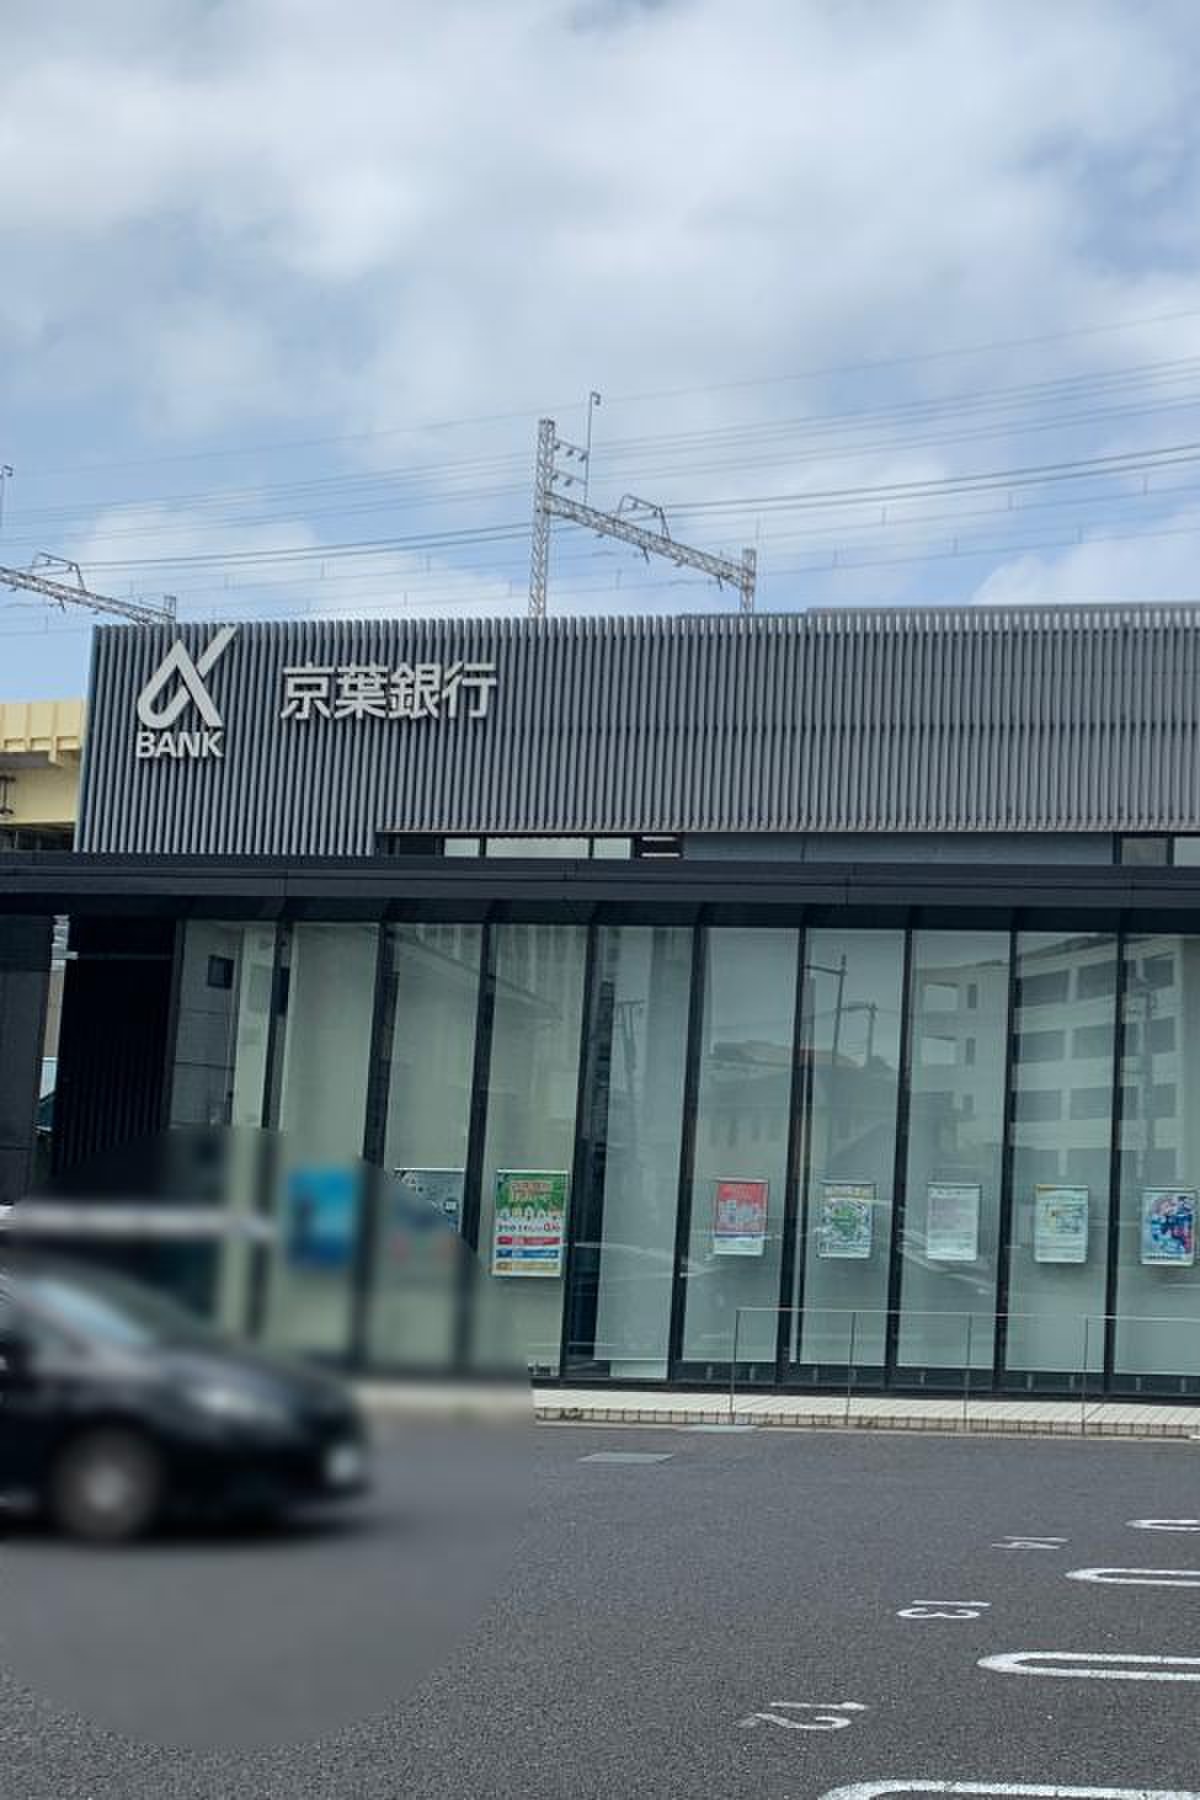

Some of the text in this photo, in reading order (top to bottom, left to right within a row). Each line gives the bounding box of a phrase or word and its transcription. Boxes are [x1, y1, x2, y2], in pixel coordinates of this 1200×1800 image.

[281, 660, 497, 721] 京葉銀行
[136, 731, 224, 758] BANK
[896, 1600, 992, 1618] 13
[737, 1701, 869, 1729] 12
